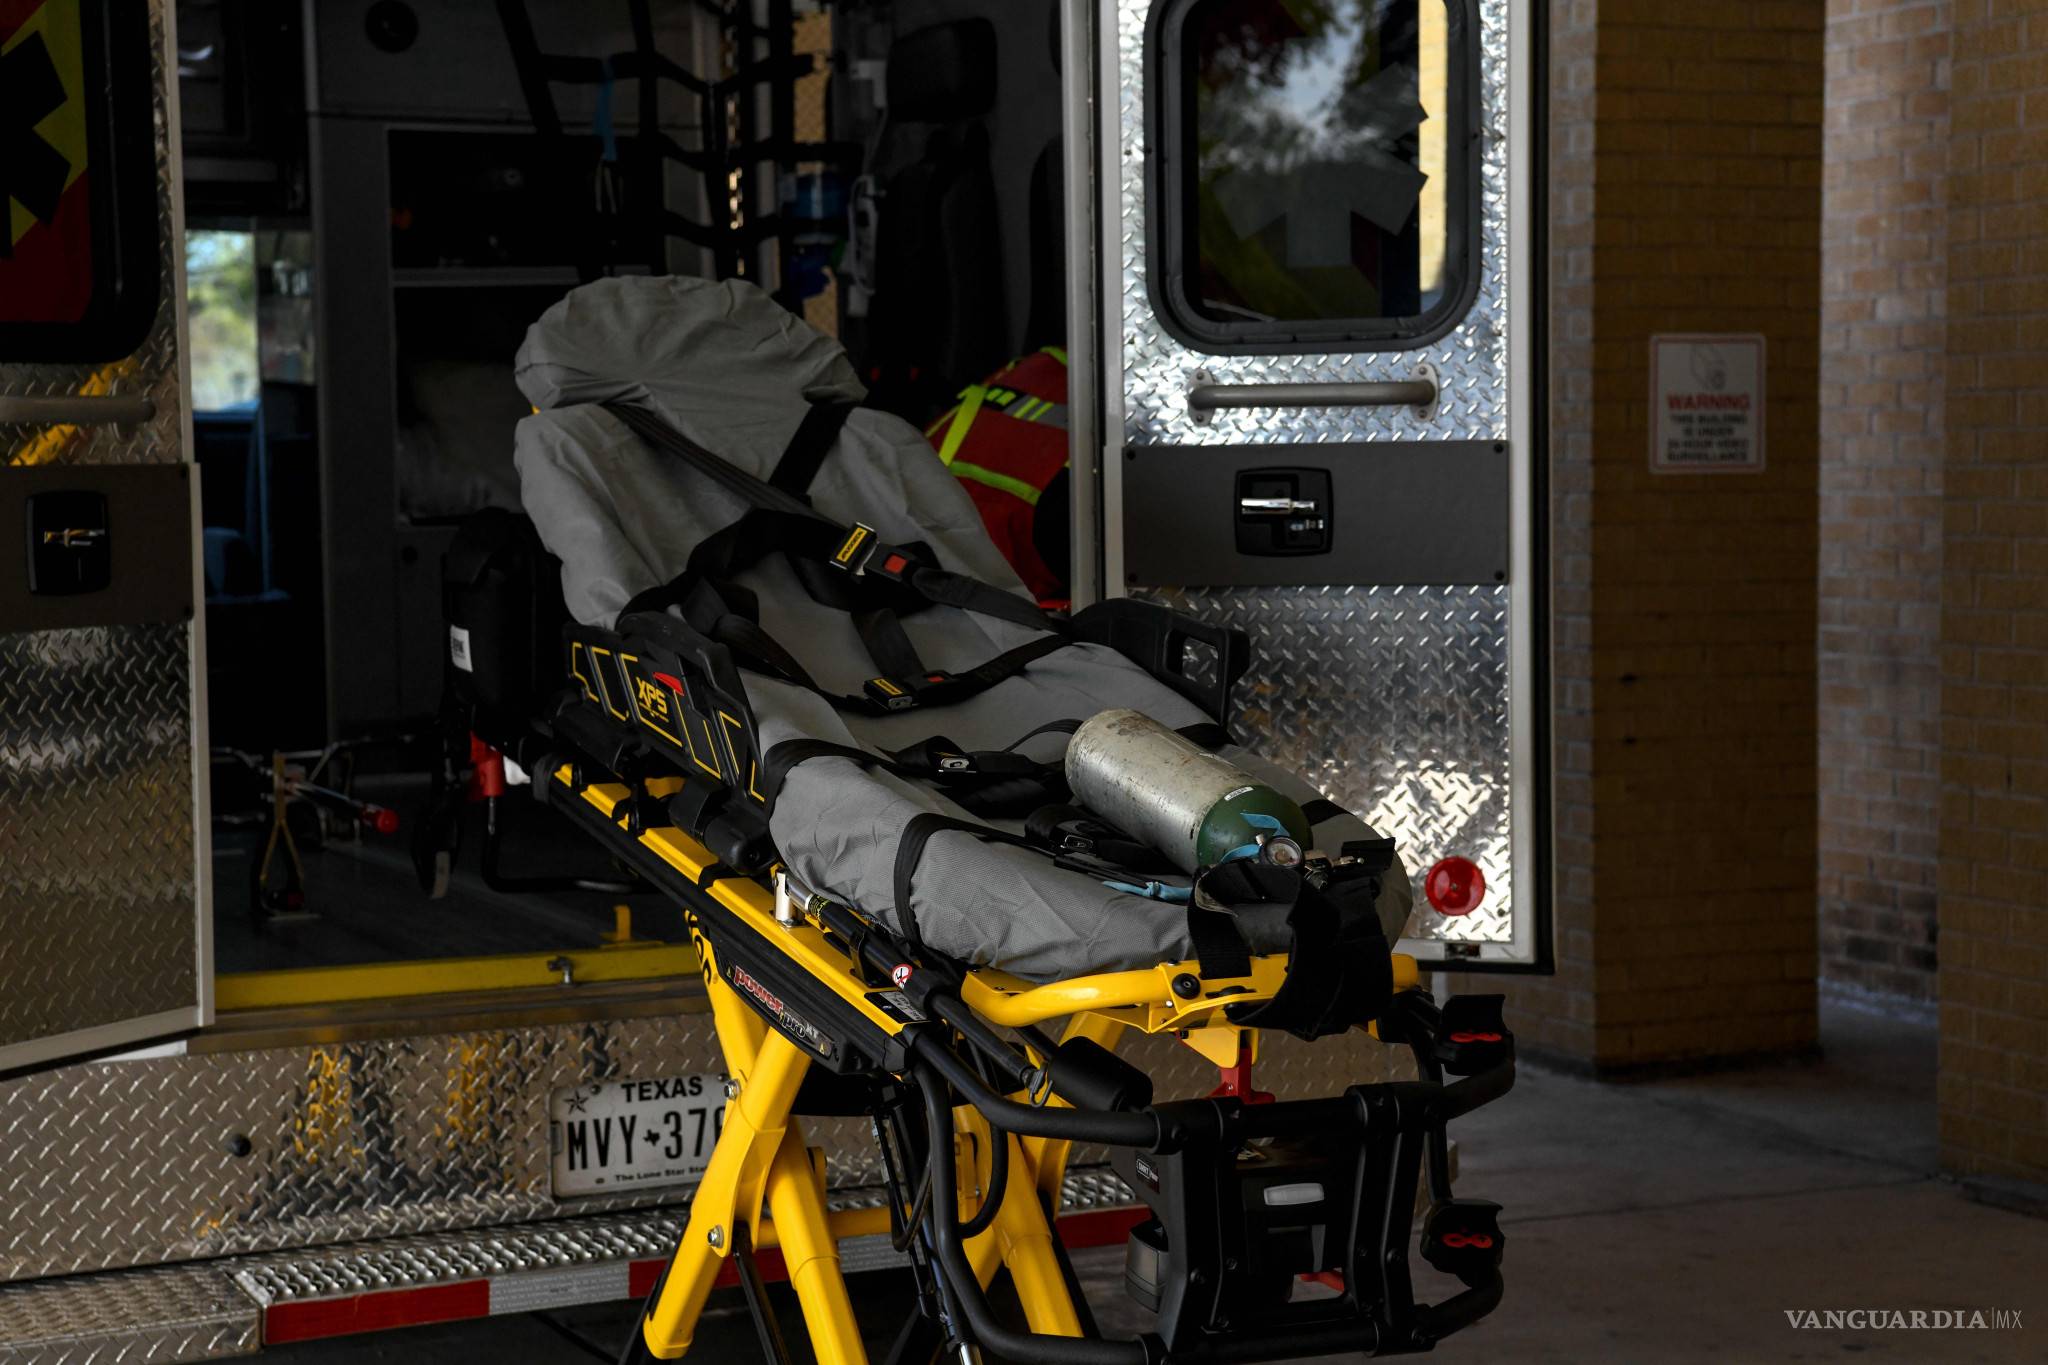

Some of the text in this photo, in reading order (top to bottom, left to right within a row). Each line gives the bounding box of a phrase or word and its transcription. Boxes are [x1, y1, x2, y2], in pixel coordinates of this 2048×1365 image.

[1667, 393, 1749, 409] WARNING
[636, 676, 668, 715] XPS
[734, 965, 784, 1016] power
[621, 1077, 702, 1102] TEXAS
[568, 1115, 636, 1170] MVY
[615, 1174, 634, 1182] The
[637, 1171, 661, 1180] Lone
[665, 1168, 685, 1177] Star
